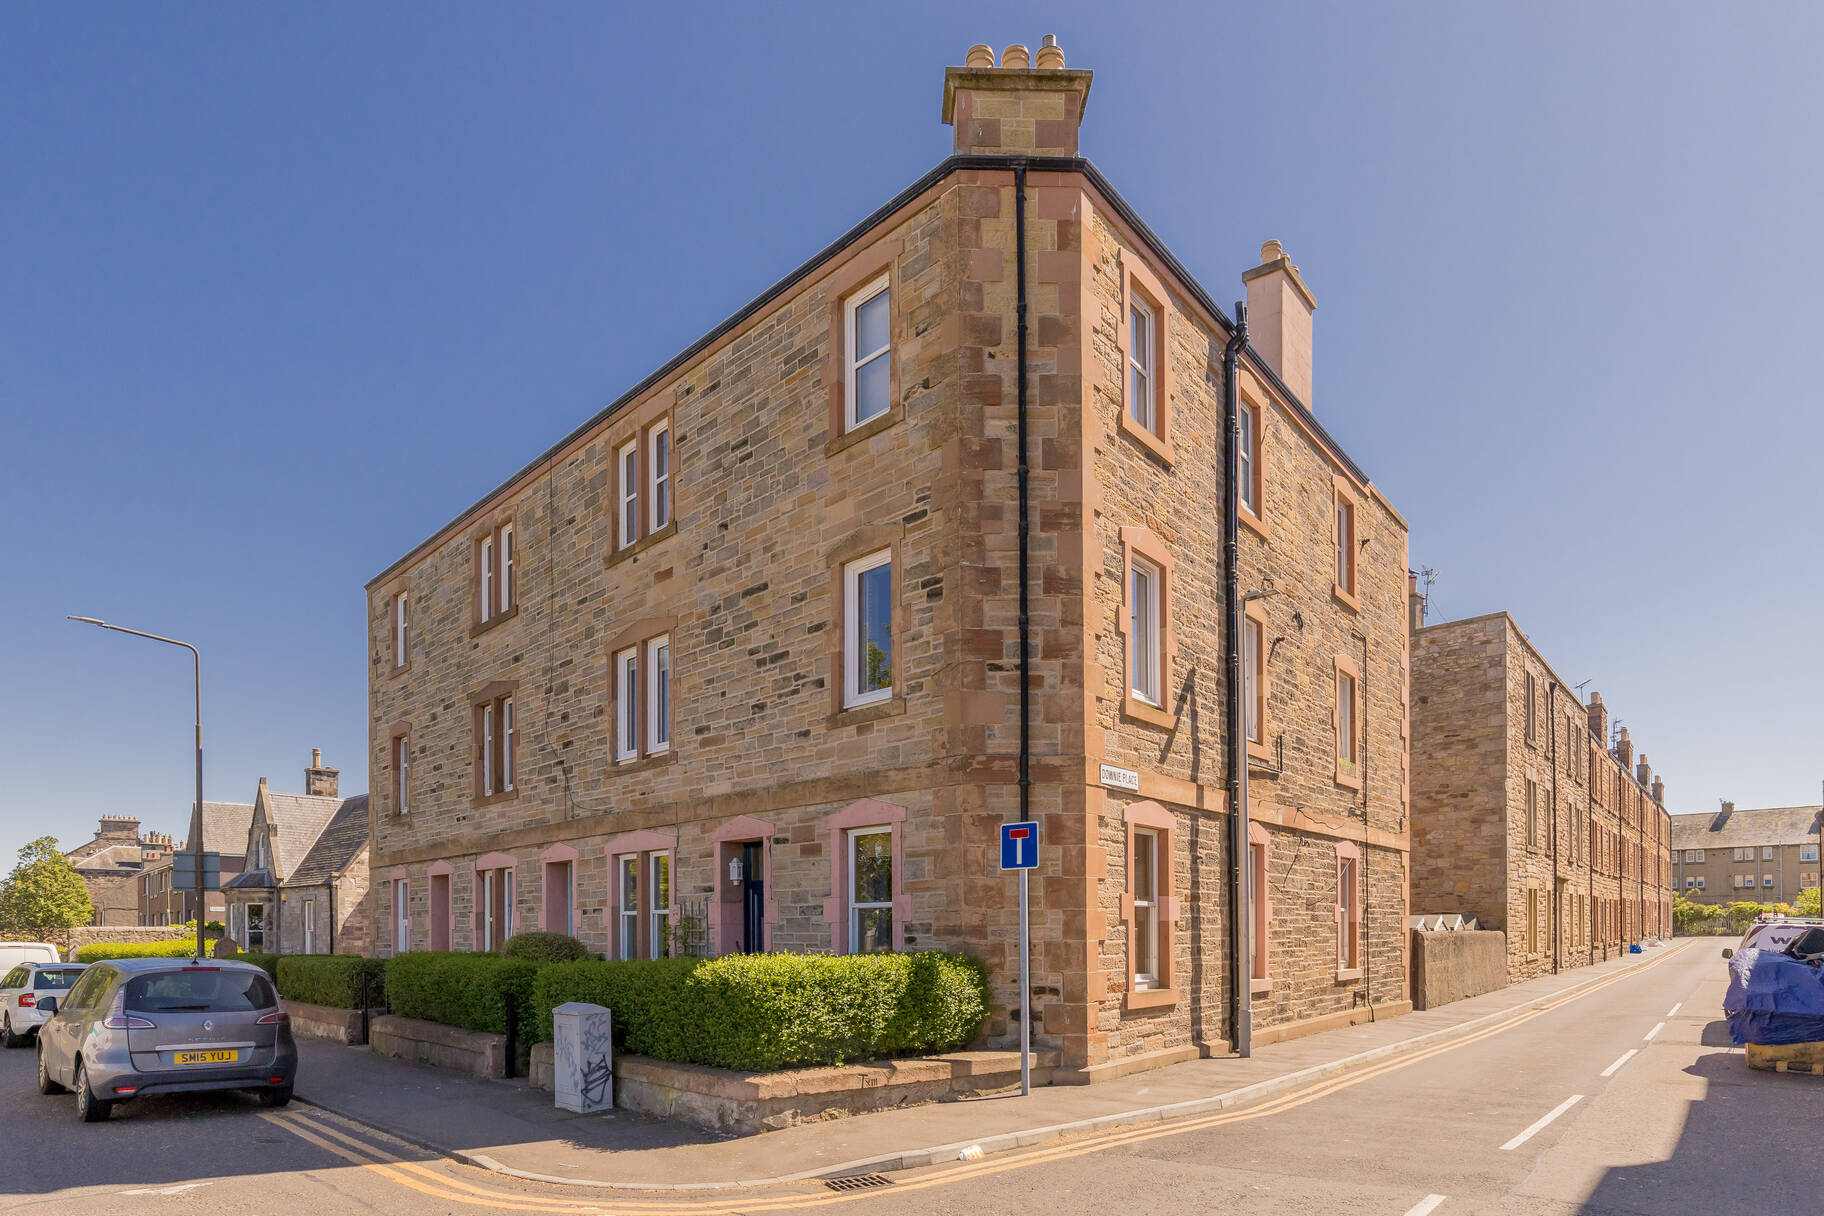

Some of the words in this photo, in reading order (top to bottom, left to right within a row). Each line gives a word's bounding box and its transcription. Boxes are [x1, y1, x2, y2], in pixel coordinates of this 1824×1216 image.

[1102, 769, 1122, 782] DOWNIE
[1123, 773, 1137, 785] PLACE
[181, 1053, 207, 1062] SM15
[210, 1051, 231, 1061] YUJ
